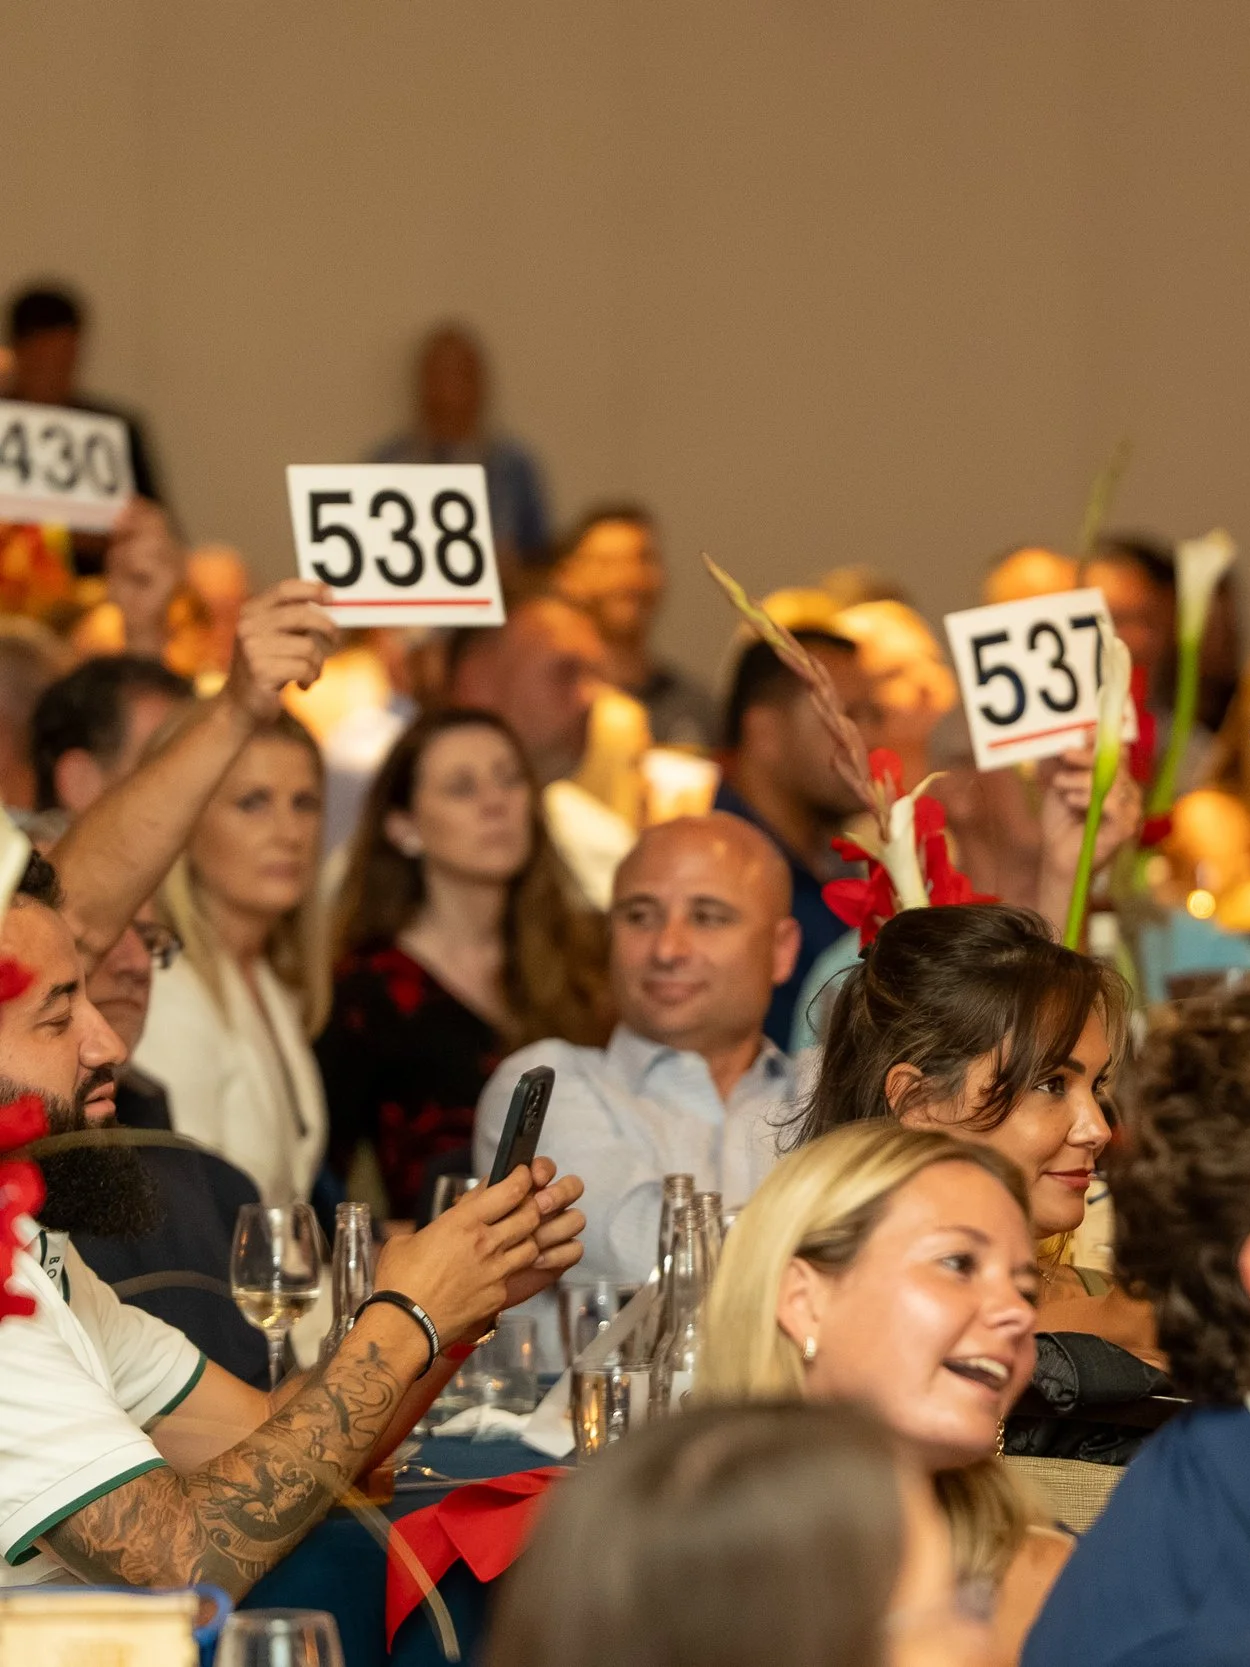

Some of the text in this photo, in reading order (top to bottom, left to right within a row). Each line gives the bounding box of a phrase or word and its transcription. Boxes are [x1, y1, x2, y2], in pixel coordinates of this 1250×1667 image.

[0, 420, 118, 496] 430
[308, 490, 486, 588] 538
[970, 614, 1103, 727] 537
